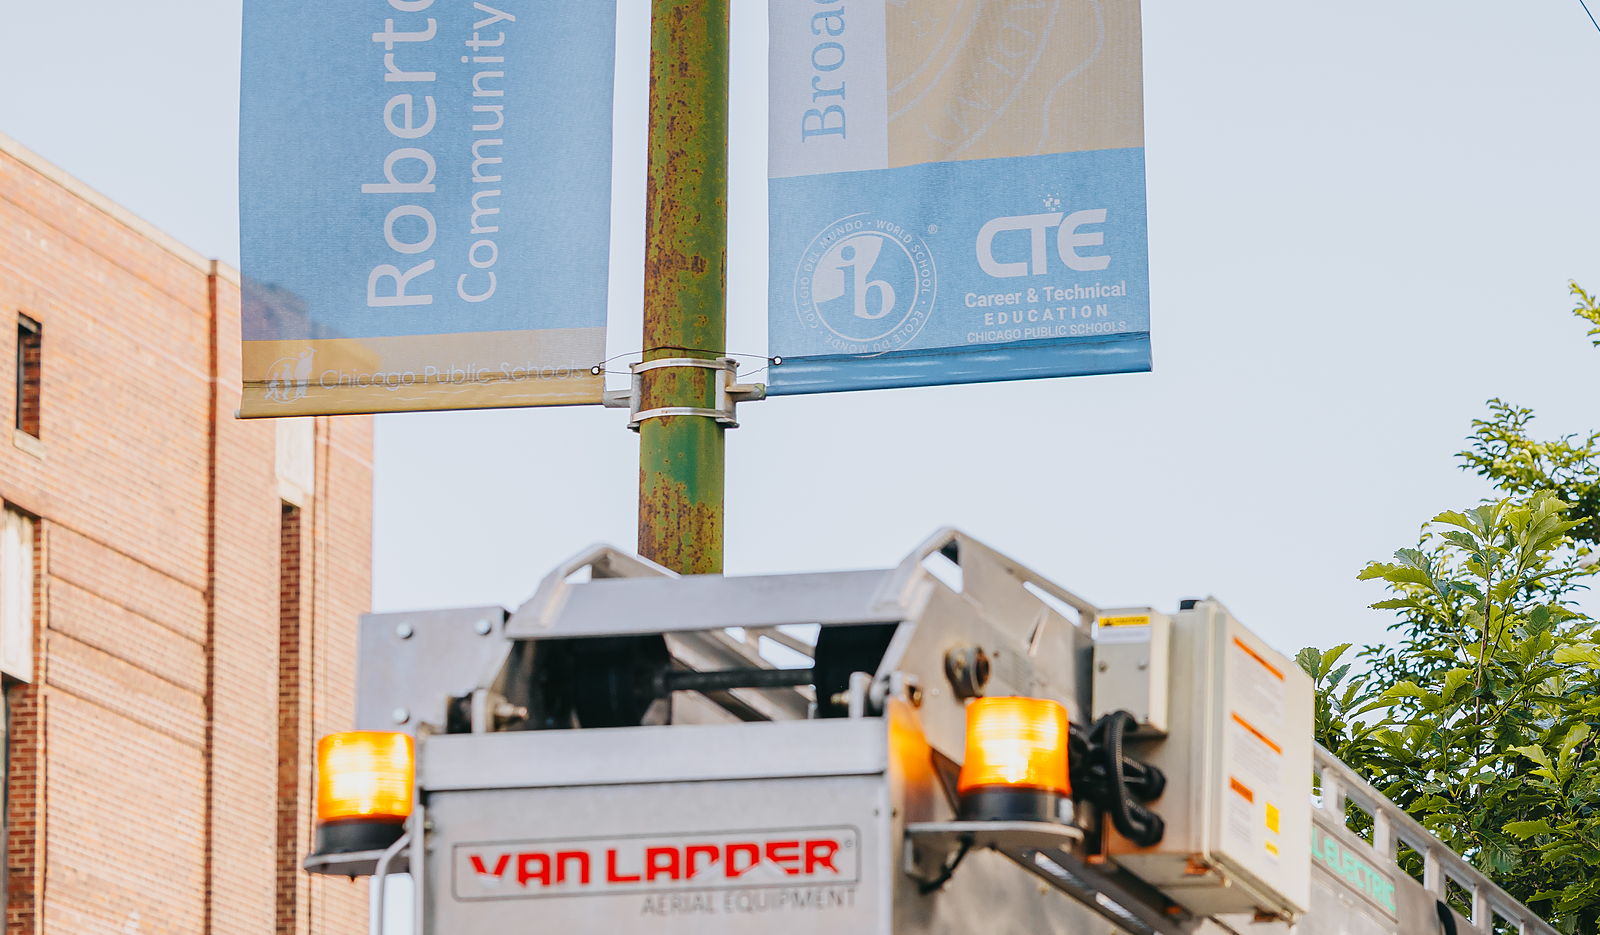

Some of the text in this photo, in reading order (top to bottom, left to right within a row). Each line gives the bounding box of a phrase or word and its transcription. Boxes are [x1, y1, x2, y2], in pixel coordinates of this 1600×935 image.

[801, 0, 847, 143] Broa
[362, 0, 437, 307] Robert
[457, 2, 516, 303] Community
[819, 219, 863, 249] MUNDO
[976, 208, 1112, 278] CTE
[876, 219, 931, 294] WORLD SCHOOL
[964, 280, 1127, 308] Career & Technical
[893, 309, 924, 342] ECOLE
[984, 303, 1108, 326] EDUCATION
[967, 320, 1127, 343] CHICAGO PUBLIC SCHOOLS
[319, 361, 584, 391] Chicago Public Schools
[470, 851, 591, 887] VAN
[640, 888, 858, 917] AERIAL EQUIPMENT
